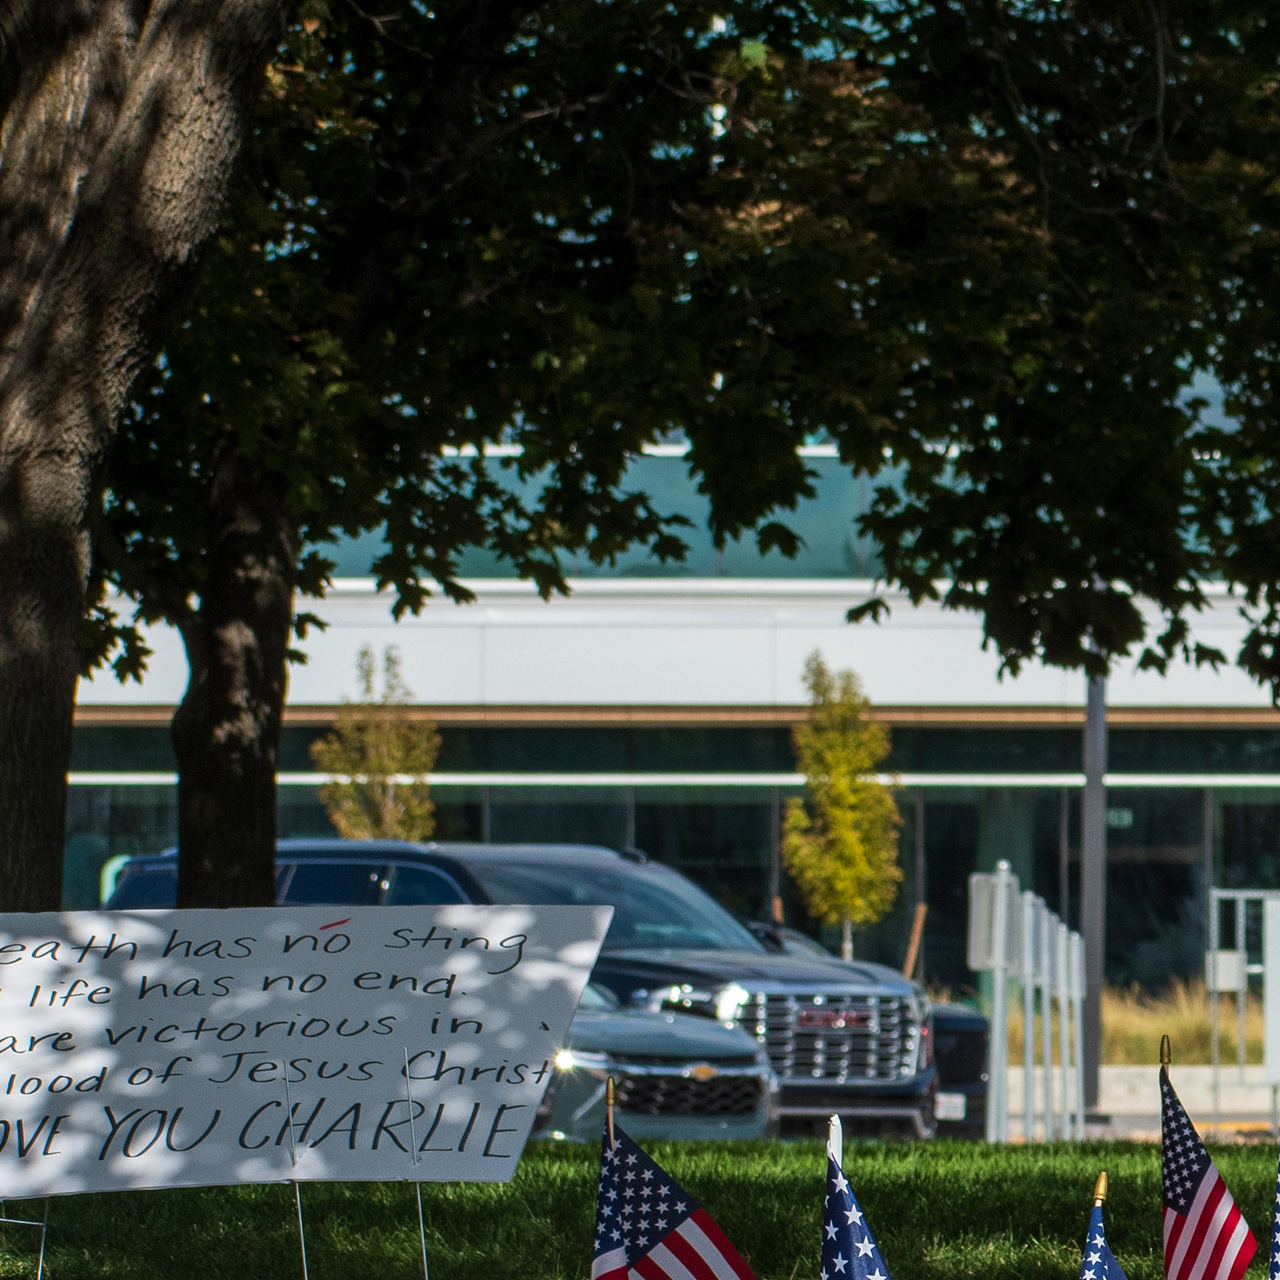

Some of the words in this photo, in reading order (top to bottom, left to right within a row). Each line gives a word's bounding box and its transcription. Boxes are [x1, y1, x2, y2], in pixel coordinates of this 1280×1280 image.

[162, 929, 257, 961] has
[282, 930, 351, 956] no
[384, 925, 528, 975] sting
[29, 982, 113, 1009] life
[138, 973, 231, 1000] has
[262, 971, 324, 995] no
[353, 970, 467, 997] end.
[0, 1030, 77, 1055] are
[105, 1011, 397, 1047] victorious
[430, 1012, 484, 1036] in
[127, 1055, 192, 1086] of
[207, 1050, 383, 1085] Jesus
[401, 1048, 550, 1086] Christ
[100, 1105, 222, 1160] YOU
[238, 1096, 529, 1159] CHARLIE
